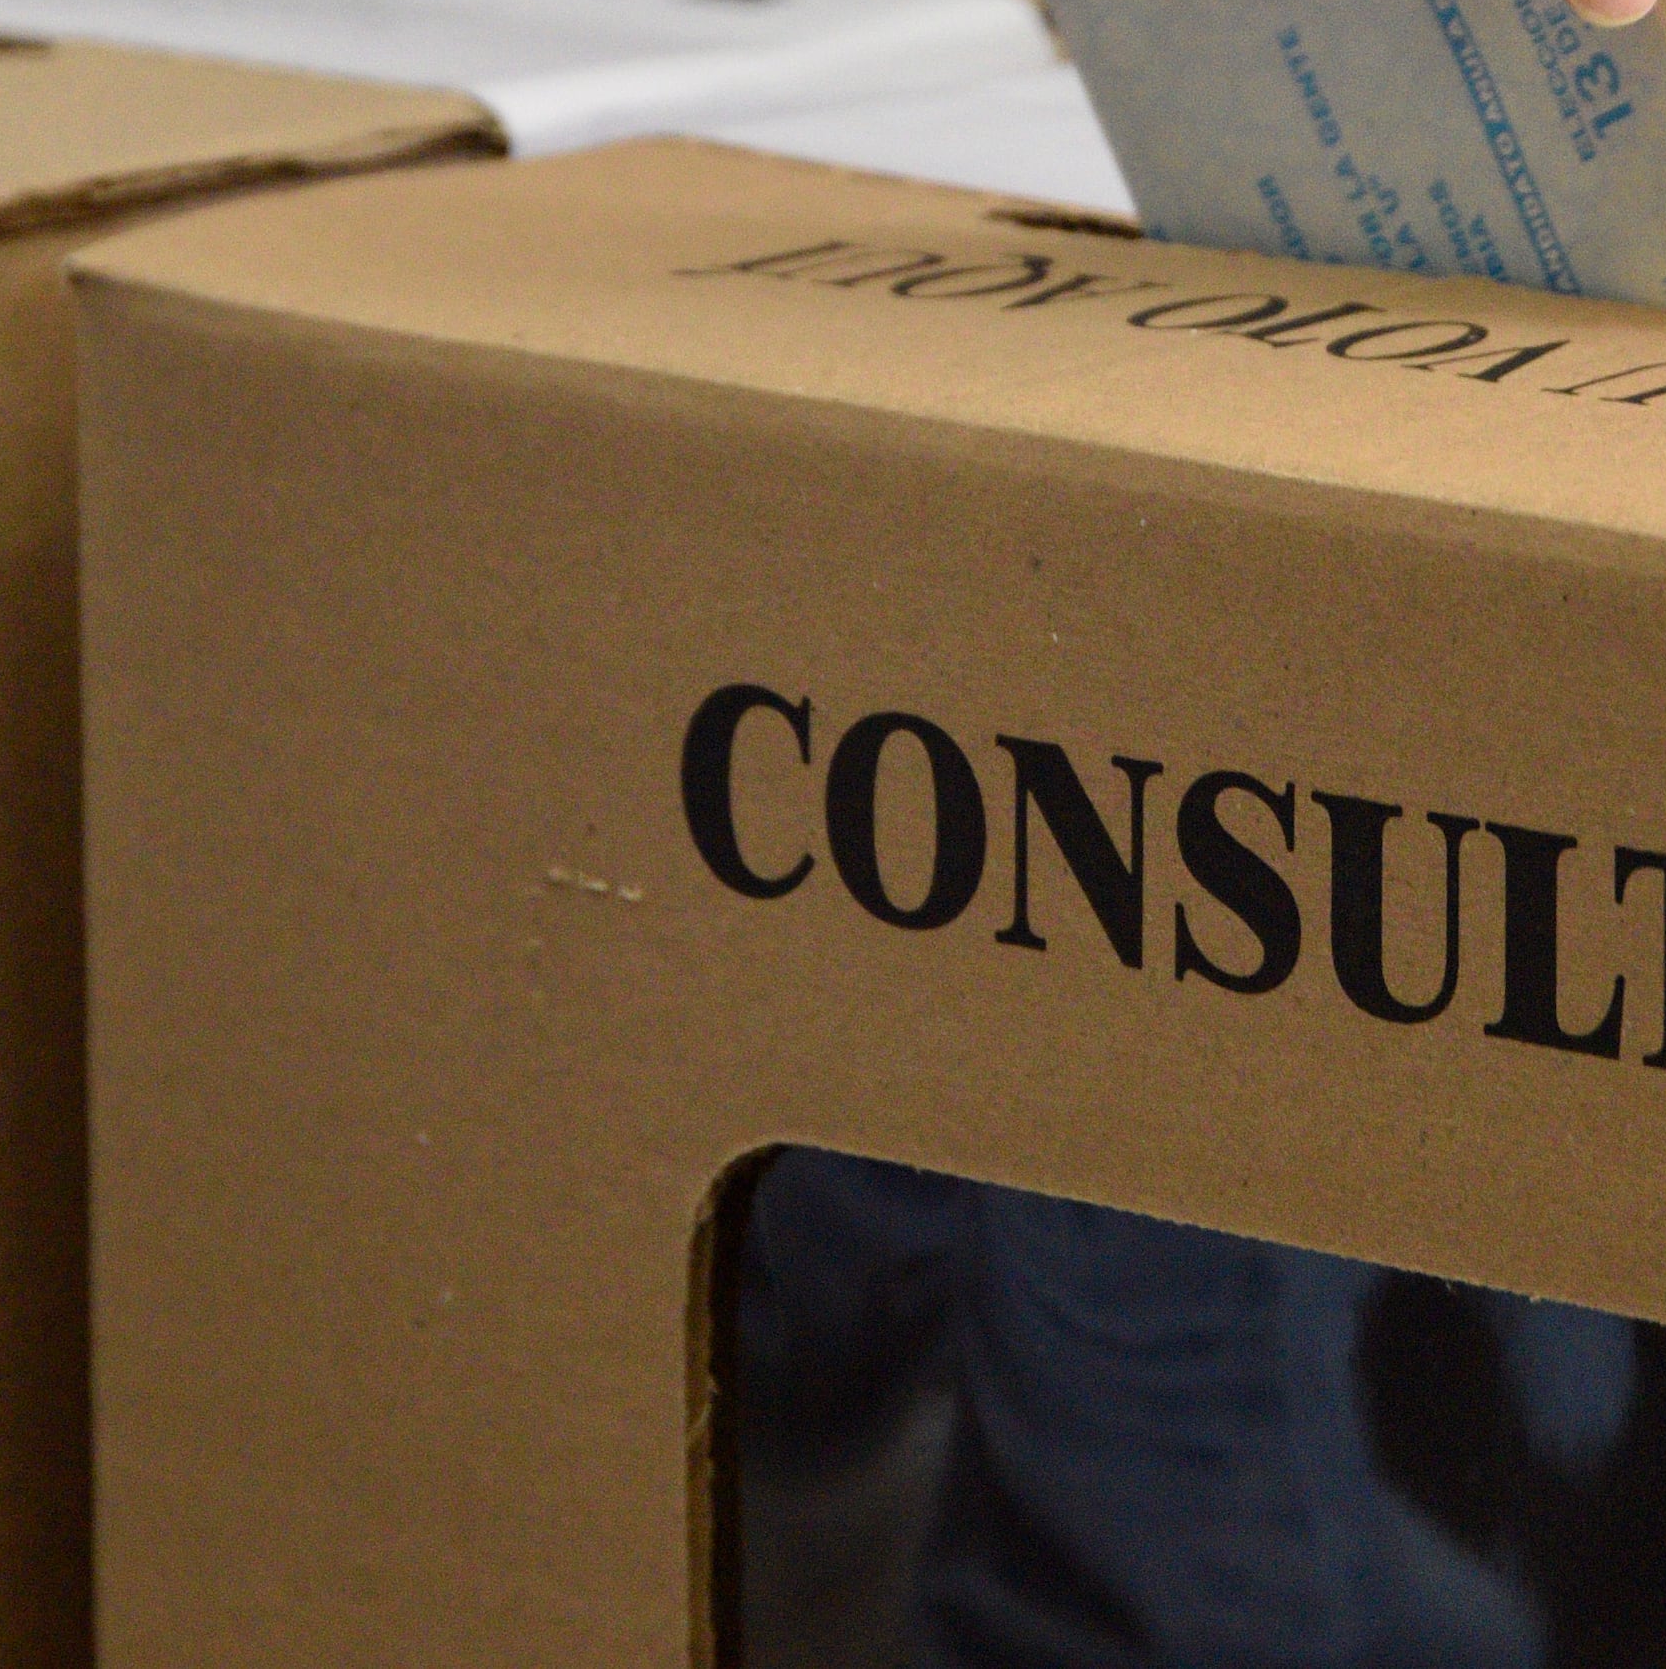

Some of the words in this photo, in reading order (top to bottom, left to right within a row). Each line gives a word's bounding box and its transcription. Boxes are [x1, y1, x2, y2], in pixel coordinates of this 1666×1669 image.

[1443, 12, 1504, 124] ANULA
[1566, 46, 1640, 141] 13
[1490, 128, 1576, 297] ANDIDATO
[1127, 291, 1570, 383] VOTO
